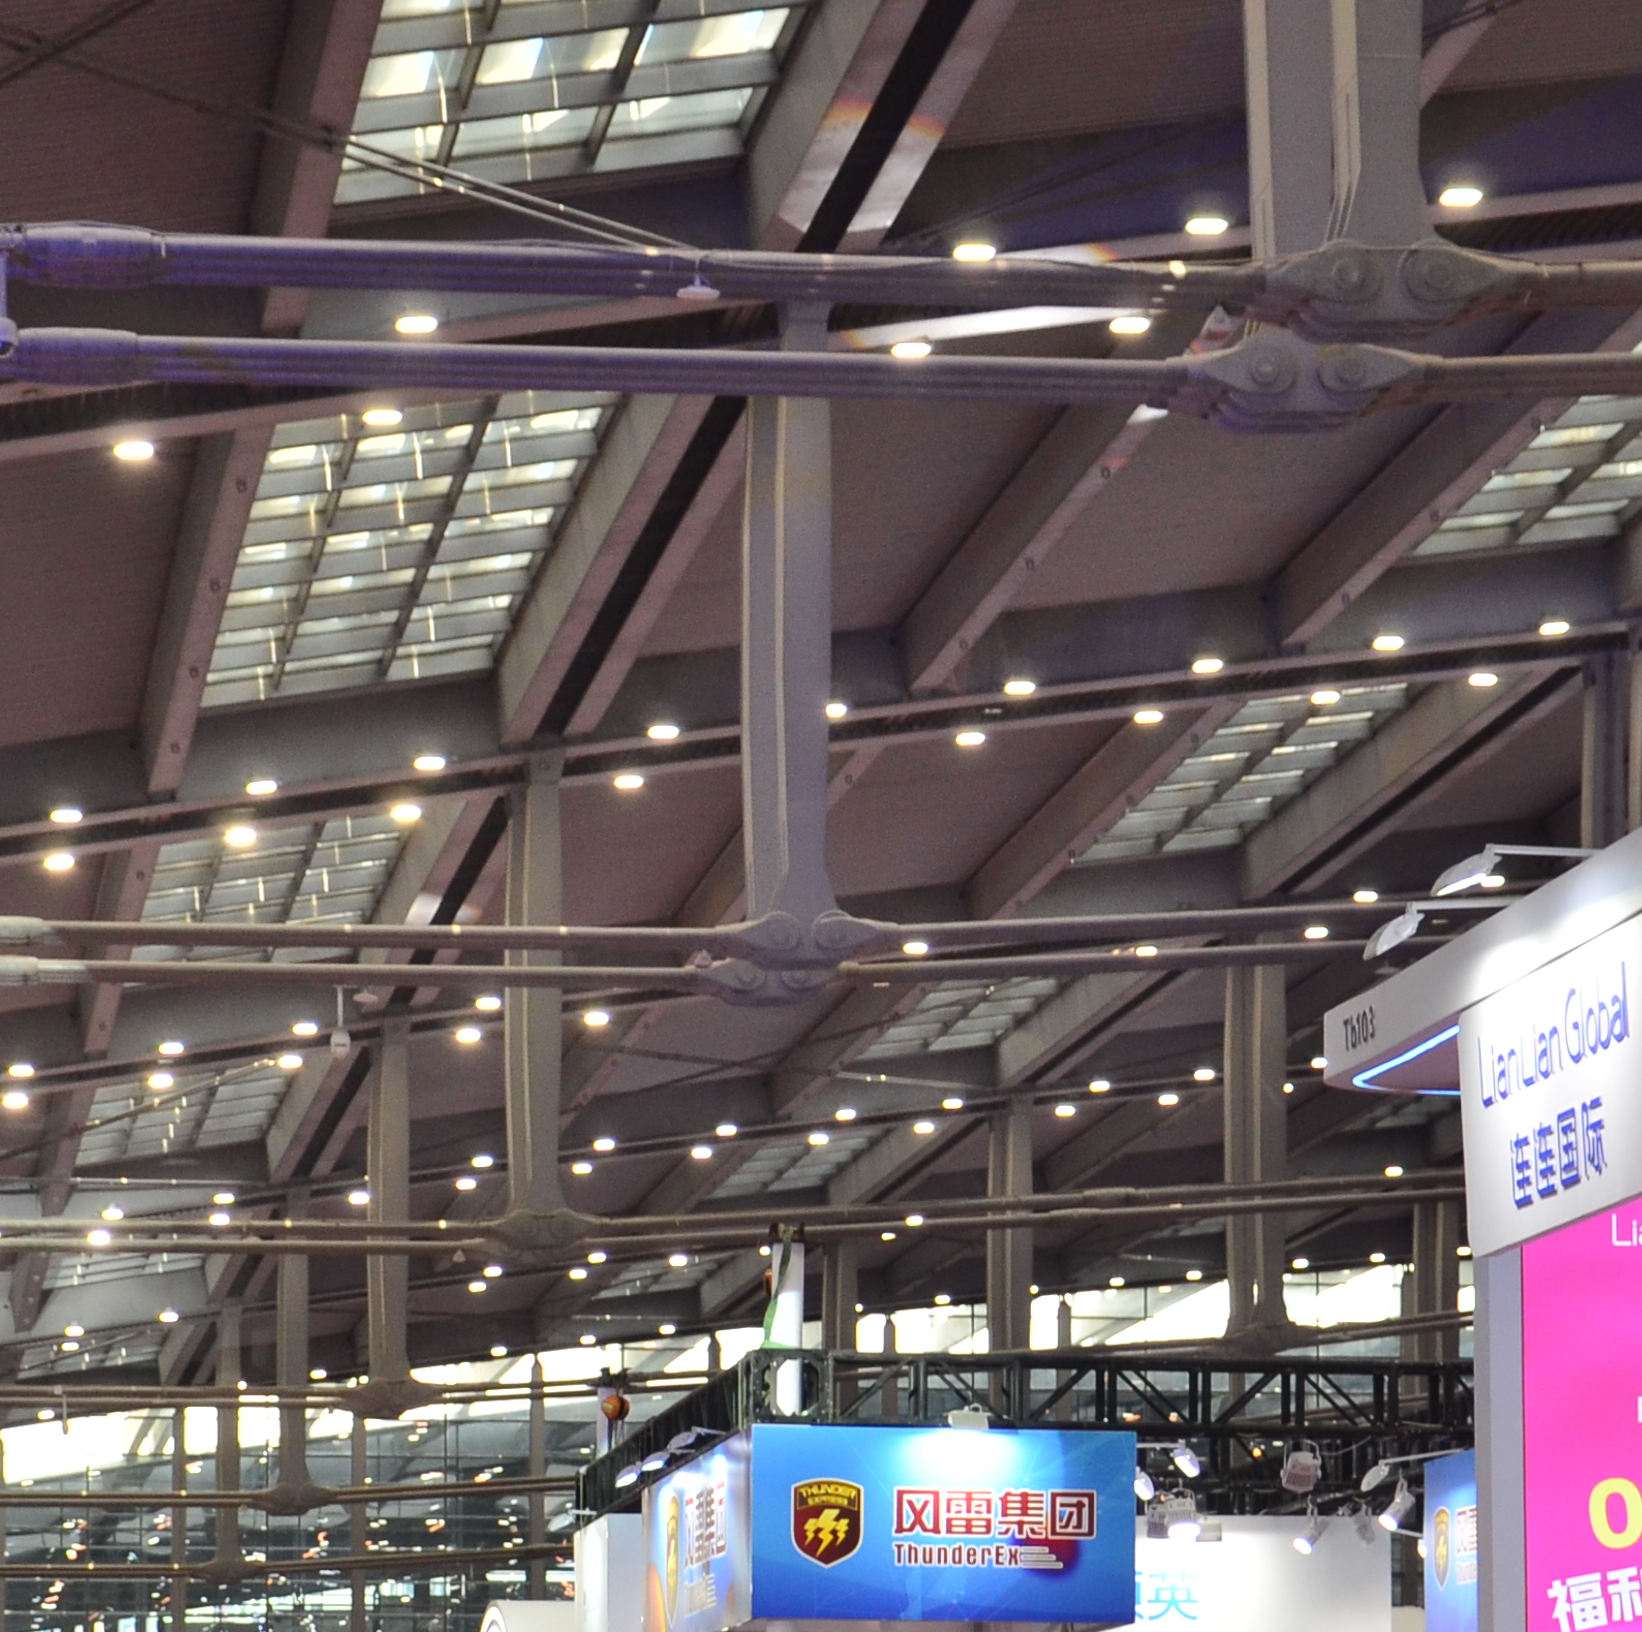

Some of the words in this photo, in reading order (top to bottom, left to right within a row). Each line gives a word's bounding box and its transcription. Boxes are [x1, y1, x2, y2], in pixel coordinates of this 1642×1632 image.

[1476, 1022, 1564, 1108] LianLian
[1564, 961, 1629, 1064] Global
[1511, 1096, 1607, 1210] 连连国际
[799, 1485, 856, 1499] THUNDER
[893, 1486, 1097, 1540] 风雷集团
[894, 1542, 1021, 1568] ThunderEx
